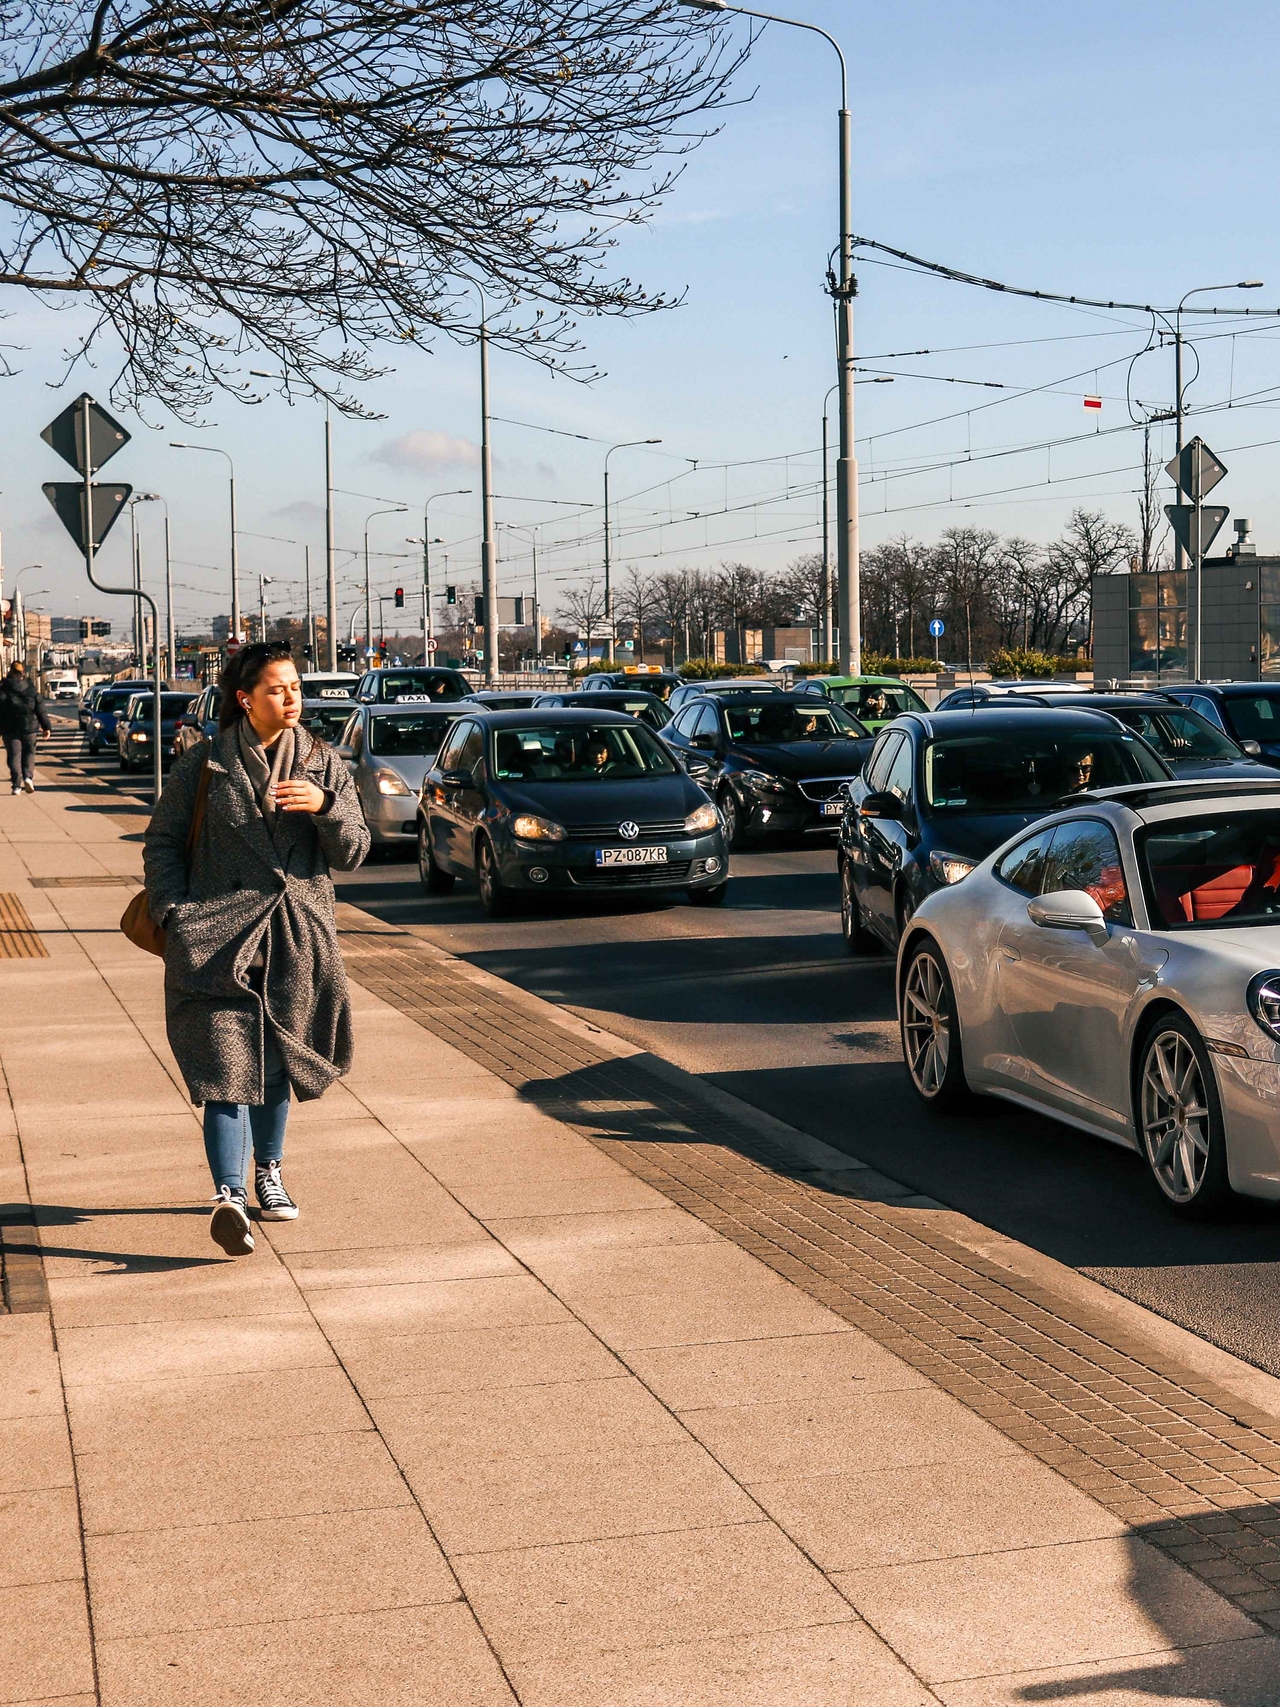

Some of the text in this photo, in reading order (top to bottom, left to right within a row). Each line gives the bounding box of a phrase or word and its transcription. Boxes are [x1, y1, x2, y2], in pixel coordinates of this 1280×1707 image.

[826, 804, 838, 814] PY
[603, 847, 666, 863] PZ 087KR
